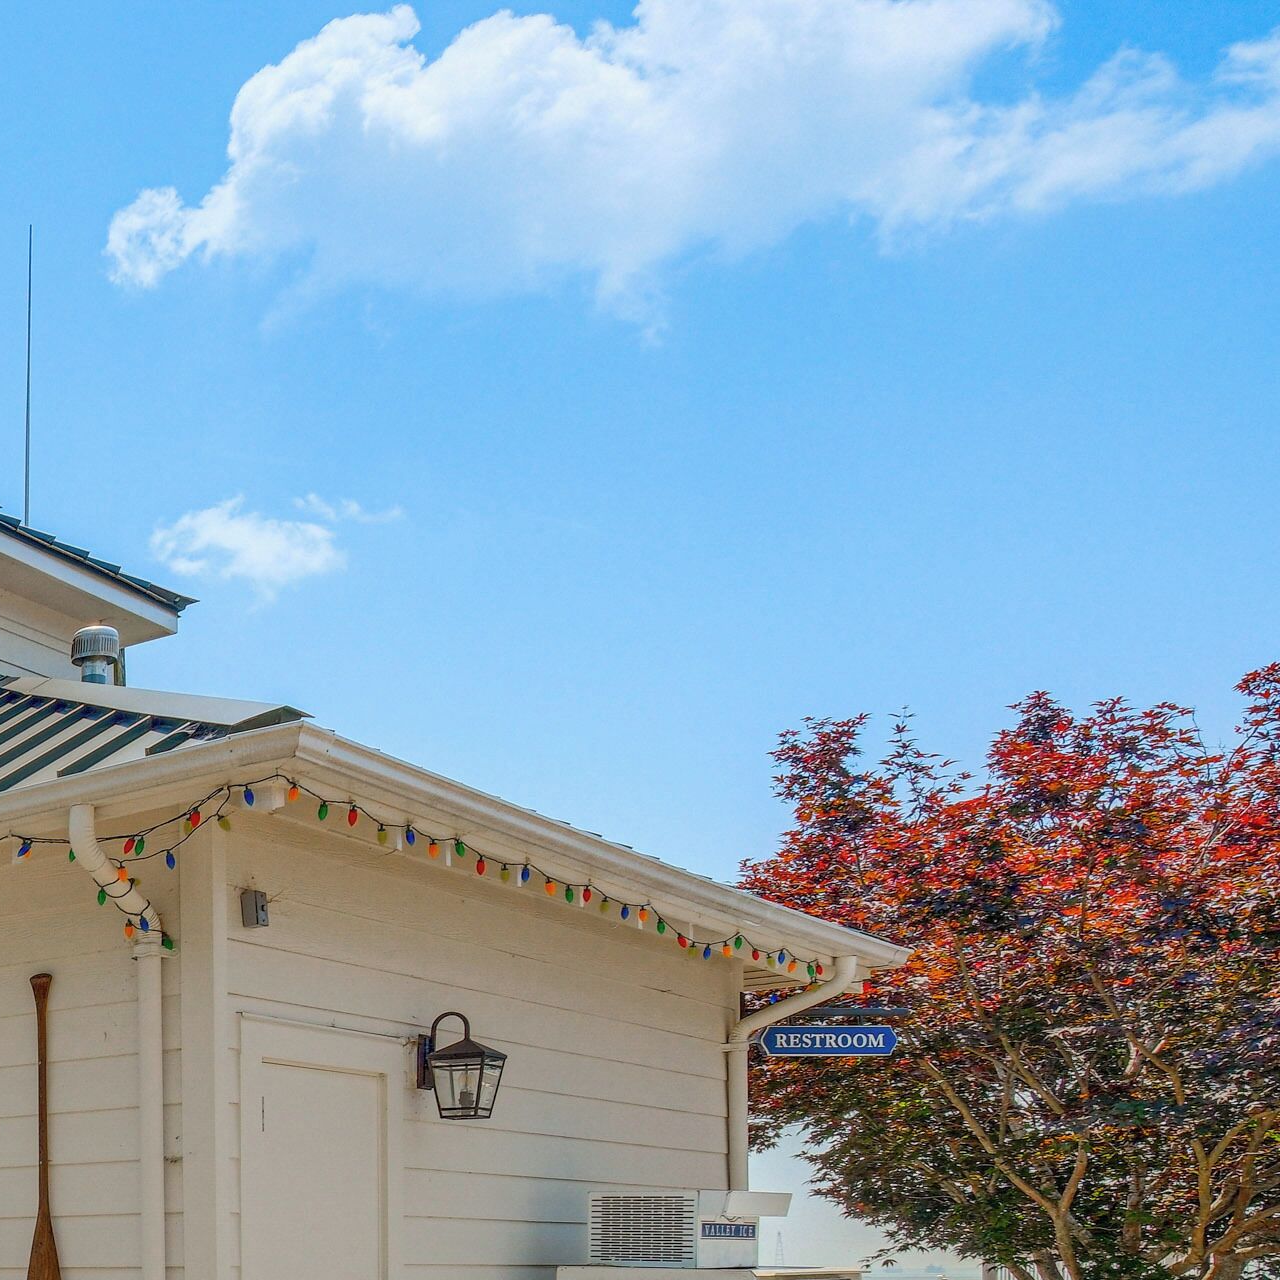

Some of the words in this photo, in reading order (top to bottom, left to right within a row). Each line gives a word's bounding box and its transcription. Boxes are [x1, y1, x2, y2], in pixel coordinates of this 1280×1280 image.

[774, 1032, 886, 1049] RESTROOM
[704, 1224, 736, 1236] VALLEY
[739, 1225, 754, 1237] ICE
